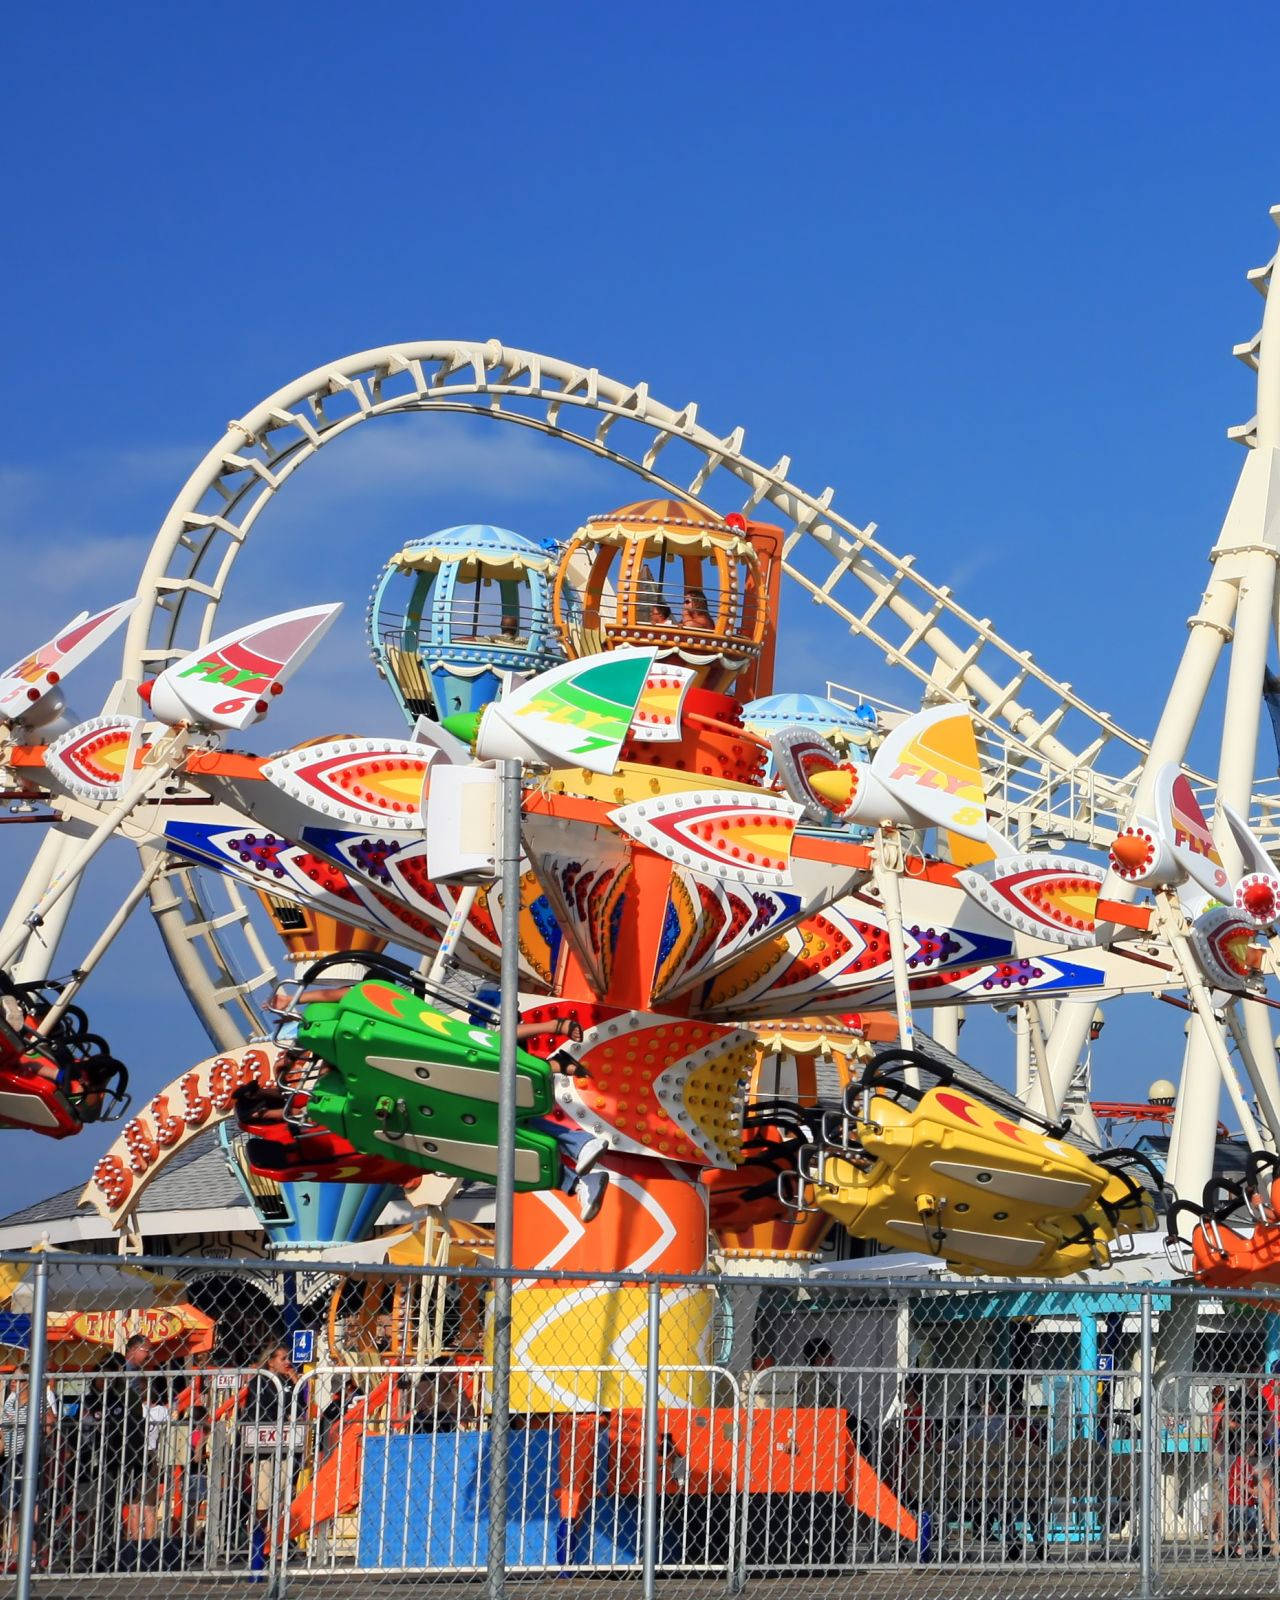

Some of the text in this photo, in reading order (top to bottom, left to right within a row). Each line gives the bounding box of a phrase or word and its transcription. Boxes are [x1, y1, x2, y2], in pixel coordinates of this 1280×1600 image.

[177, 661, 269, 687] FLY
[212, 697, 256, 715] 6
[514, 700, 622, 729] FLY
[566, 736, 619, 754] 7
[888, 762, 975, 794] FLY
[952, 807, 984, 827] 8
[1174, 828, 1213, 857] FLY
[1214, 869, 1228, 888] 9
[299, 1335, 306, 1349] 4
[1099, 1358, 1107, 1370] 5
[218, 1375, 235, 1385] EXIT
[259, 1430, 290, 1442] EXT
